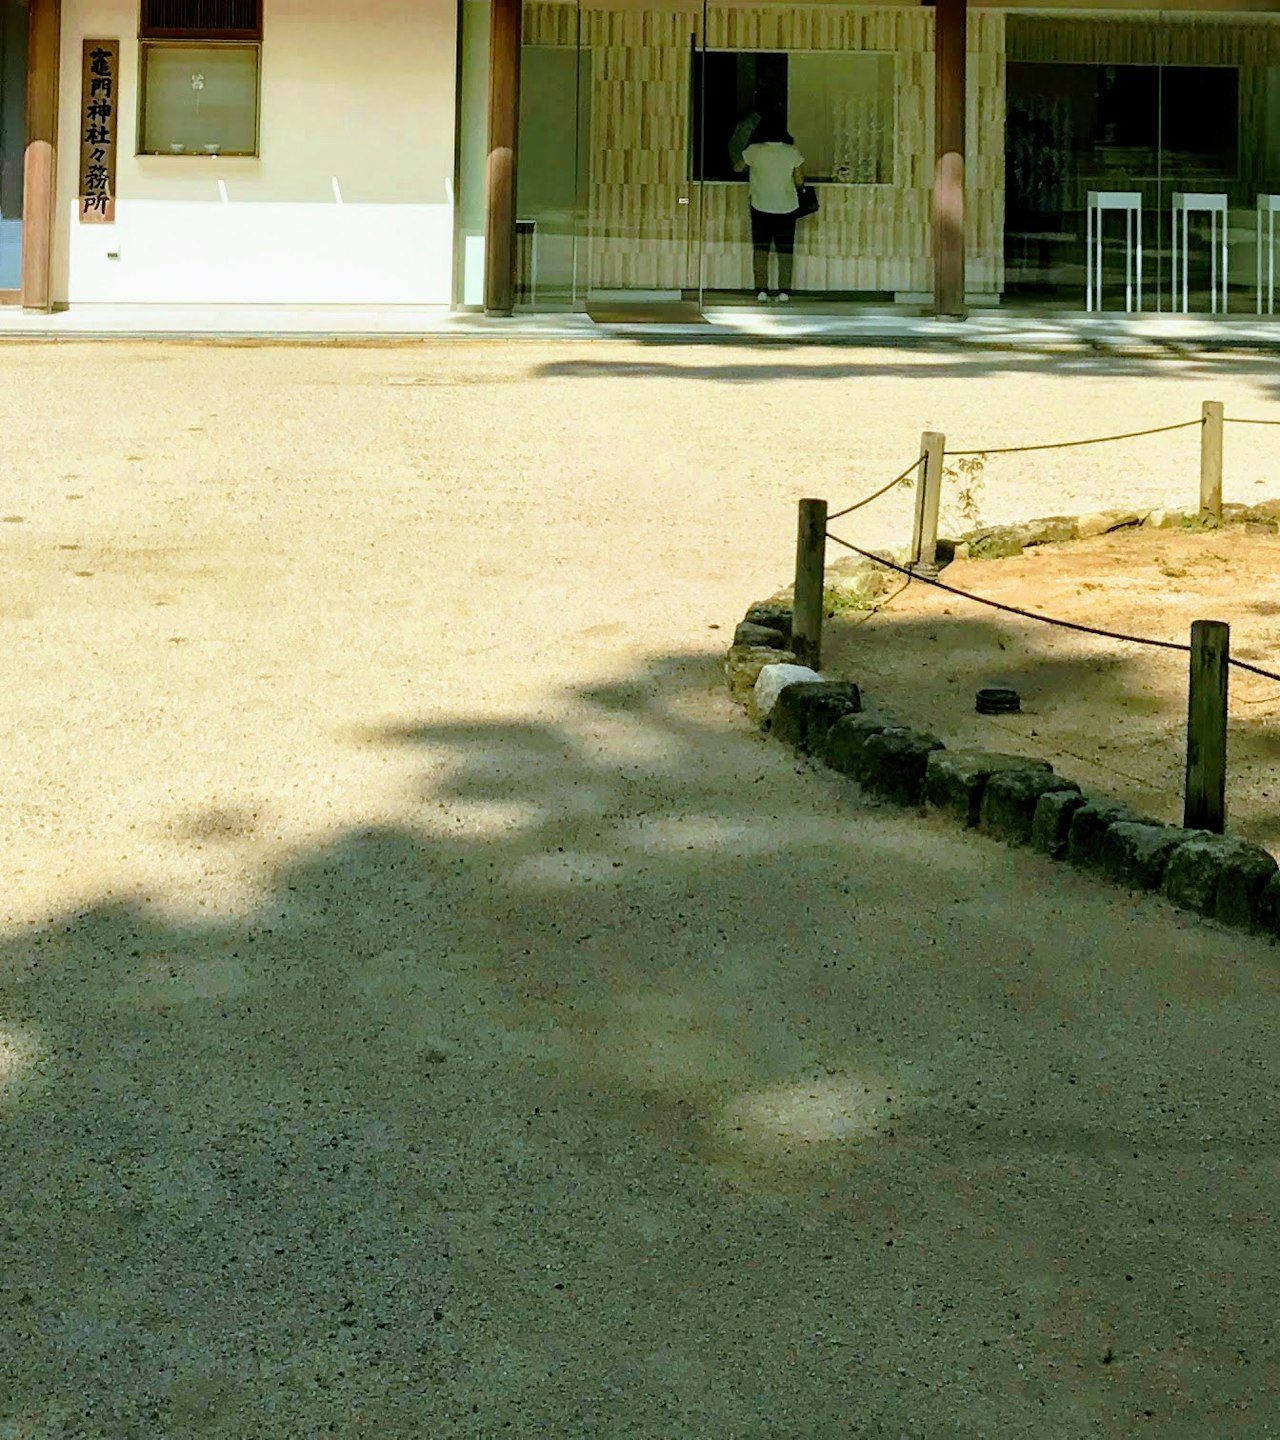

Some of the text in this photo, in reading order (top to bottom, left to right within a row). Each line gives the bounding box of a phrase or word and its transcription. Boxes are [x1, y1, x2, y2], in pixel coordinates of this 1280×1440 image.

[83, 47, 112, 214] 竈門神社々務所
